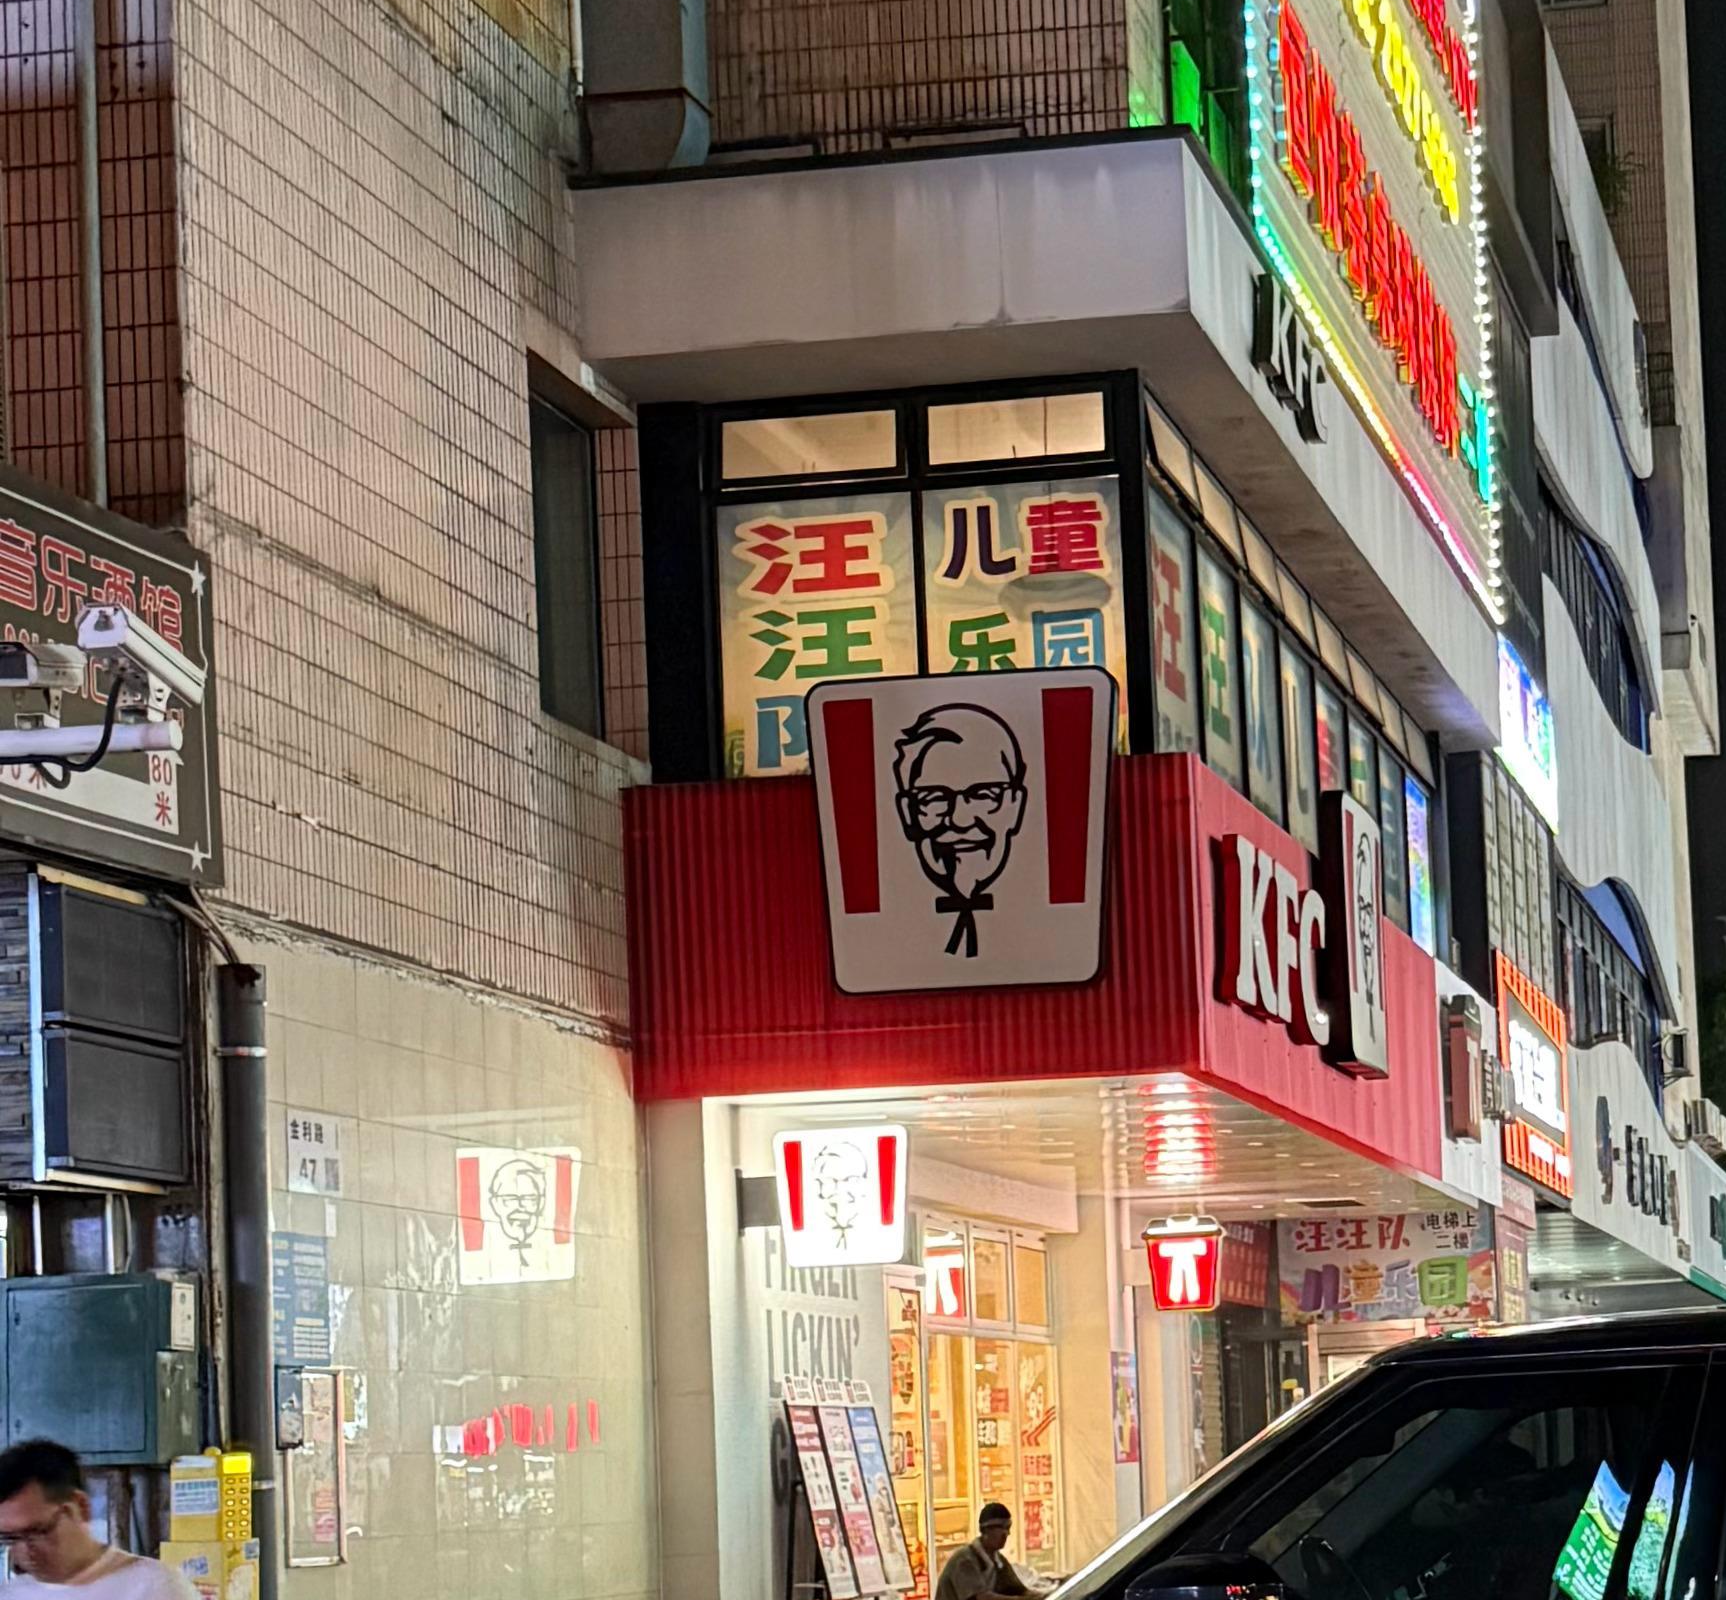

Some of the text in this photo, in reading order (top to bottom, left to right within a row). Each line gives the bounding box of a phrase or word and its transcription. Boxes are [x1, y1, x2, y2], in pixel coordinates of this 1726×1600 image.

[1271, 275, 1328, 445] KFC
[942, 500, 1104, 580] 儿童
[152, 754, 173, 786] 80
[155, 791, 172, 827] 米
[1233, 834, 1330, 1045] KFC
[1295, 1214, 1410, 1252] 汪汪队
[1426, 1211, 1477, 1231] 电梯上
[1436, 1233, 1470, 1250] 二楼
[1299, 1257, 1469, 1313] 儿童乐园
